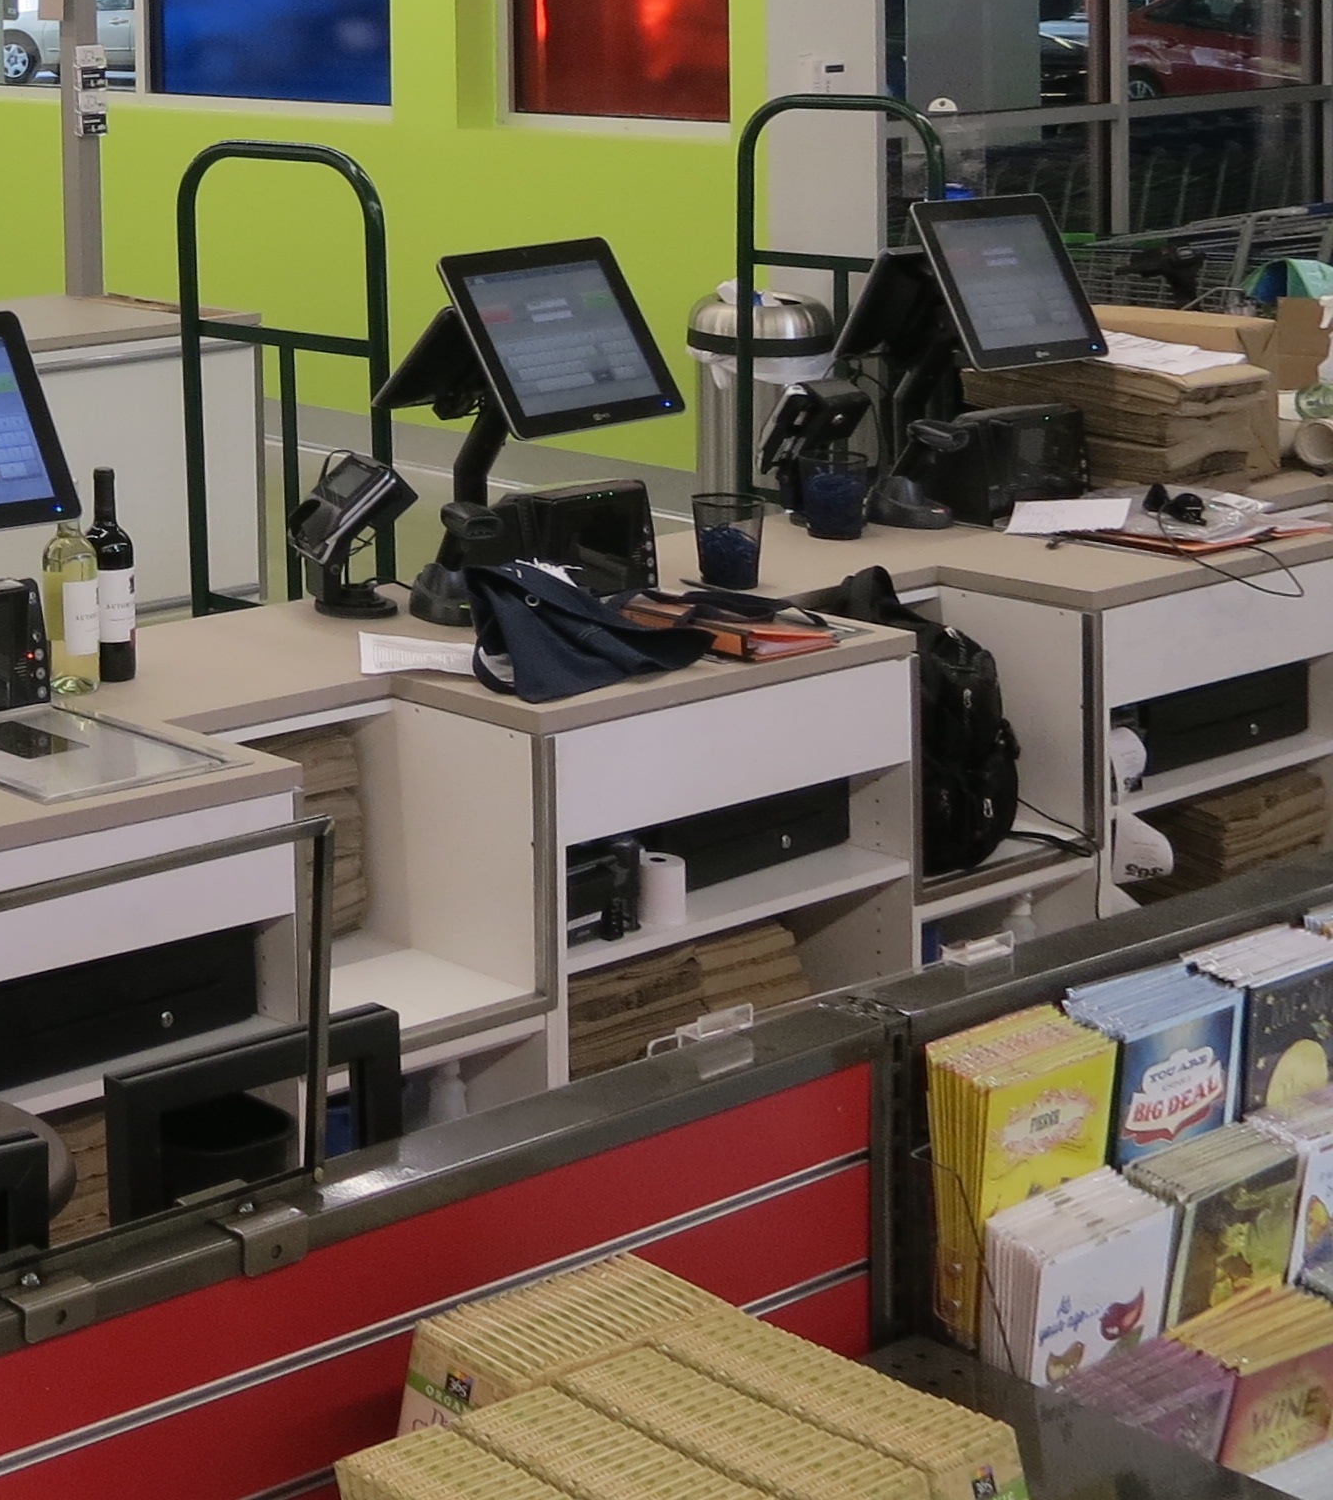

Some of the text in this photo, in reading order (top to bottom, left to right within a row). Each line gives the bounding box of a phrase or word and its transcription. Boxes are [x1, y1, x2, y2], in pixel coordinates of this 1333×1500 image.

[1149, 1065, 1176, 1084] YOU
[1177, 1053, 1208, 1073] ARE
[1134, 1100, 1164, 1122] BIG
[1167, 1076, 1218, 1117] DEAL
[447, 1376, 468, 1398] 365
